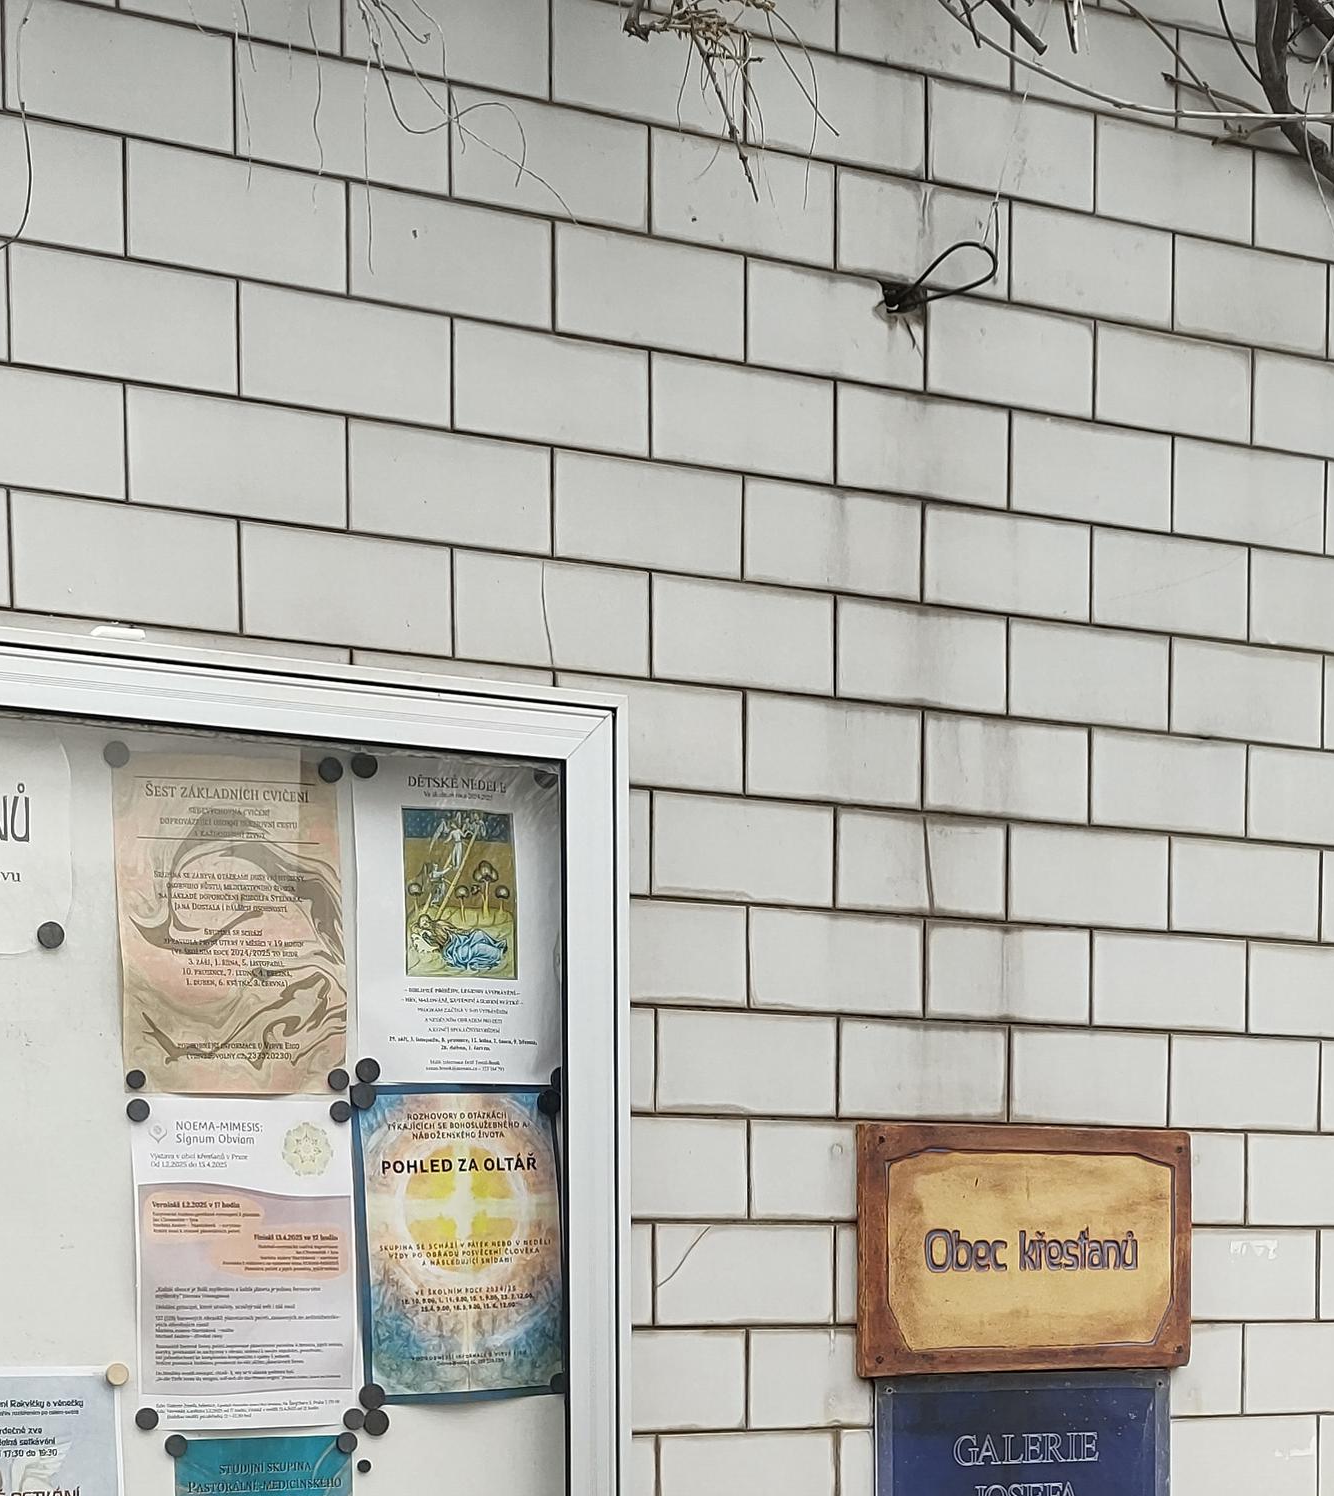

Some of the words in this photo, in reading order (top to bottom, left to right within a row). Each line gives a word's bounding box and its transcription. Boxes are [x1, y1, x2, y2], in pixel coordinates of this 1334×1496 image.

[145, 781, 176, 798] ŠEST
[181, 784, 258, 801] ZÁKLADNÍCH
[263, 787, 309, 803] CVIČENÍ
[407, 1112, 457, 1120] ROZHOVORY
[460, 1112, 465, 1120] O
[467, 1111, 506, 1119] OTÁZKÁCH
[450, 1120, 519, 1129] BOHOSLUŽEBNÉHO
[176, 1133, 215, 1145] Signum
[219, 1134, 254, 1145] Obviam
[412, 1130, 476, 1140] NÁBOŽENSKÉHO
[478, 1129, 505, 1139] ŽIVOTA
[382, 1160, 452, 1175] POHLED
[458, 1158, 478, 1171] ZA
[484, 1153, 537, 1170] OLTÁŘ
[505, 1247, 539, 1255] ČLOVĚKA
[924, 1228, 1007, 1273] Obec
[1018, 1226, 1139, 1272] křesťanů
[10, 1400, 45, 1409] Rakvičky
[53, 1400, 84, 1408] věnečky
[19, 1437, 55, 1446] setkávání
[4, 1450, 24, 1458] 17:30
[953, 1432, 1099, 1467] GALERIE
